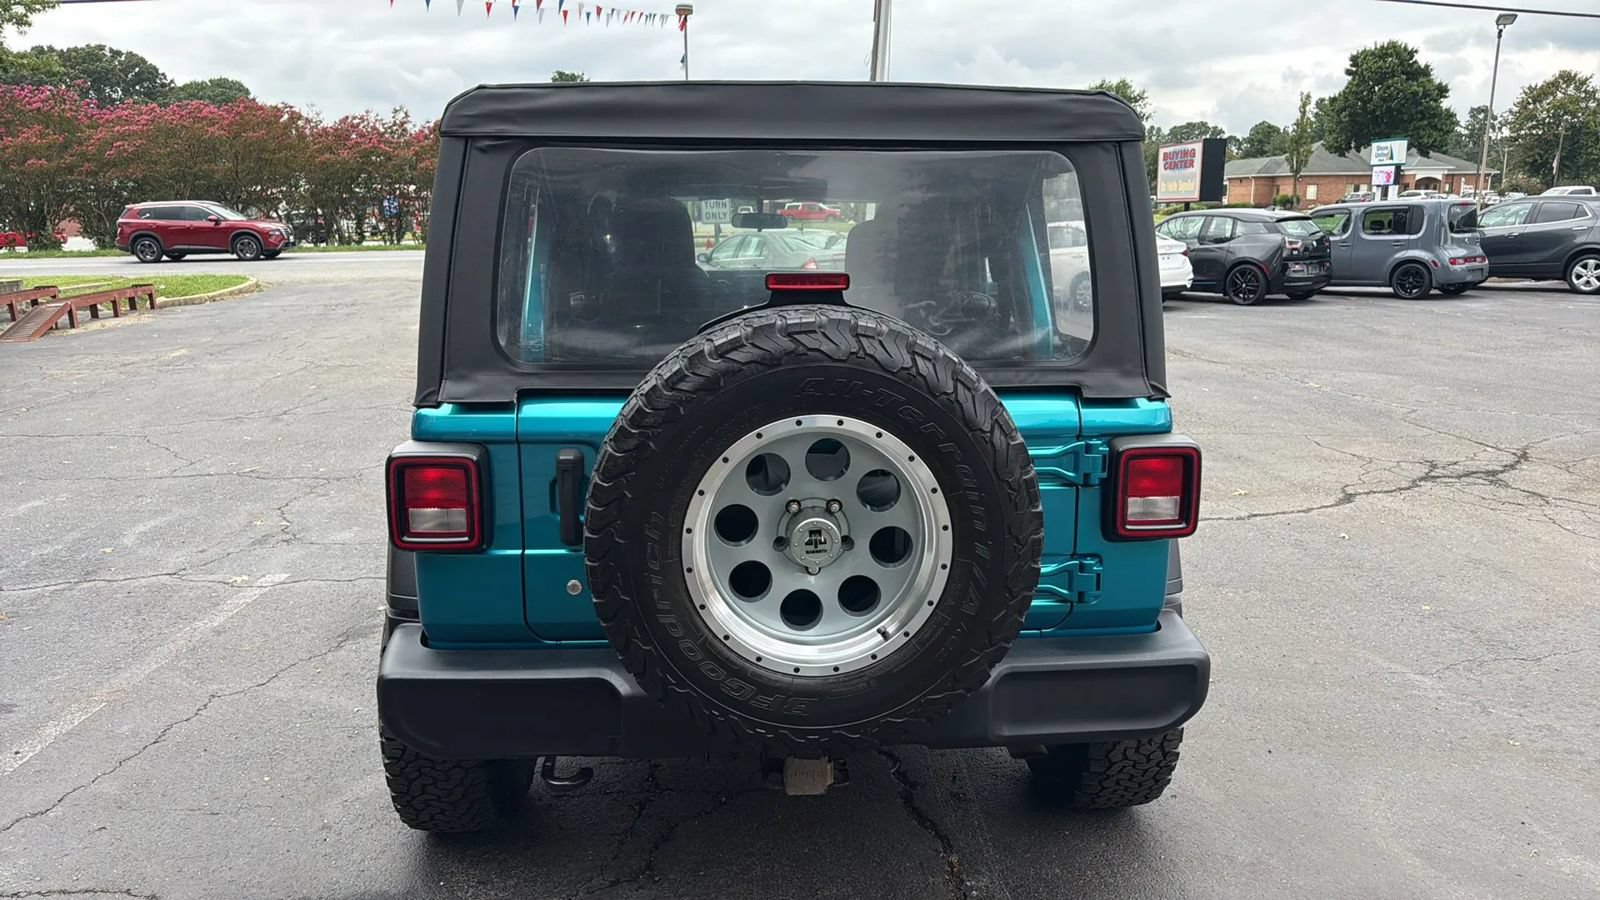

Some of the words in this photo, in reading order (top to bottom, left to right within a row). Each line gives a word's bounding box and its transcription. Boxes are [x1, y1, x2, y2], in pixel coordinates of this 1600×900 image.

[1163, 148, 1197, 161] BUYING
[1163, 159, 1195, 171] CENTER
[704, 201, 726, 209] TURN
[705, 211, 727, 219] ONLY
[643, 511, 819, 716] BFGoodrich
